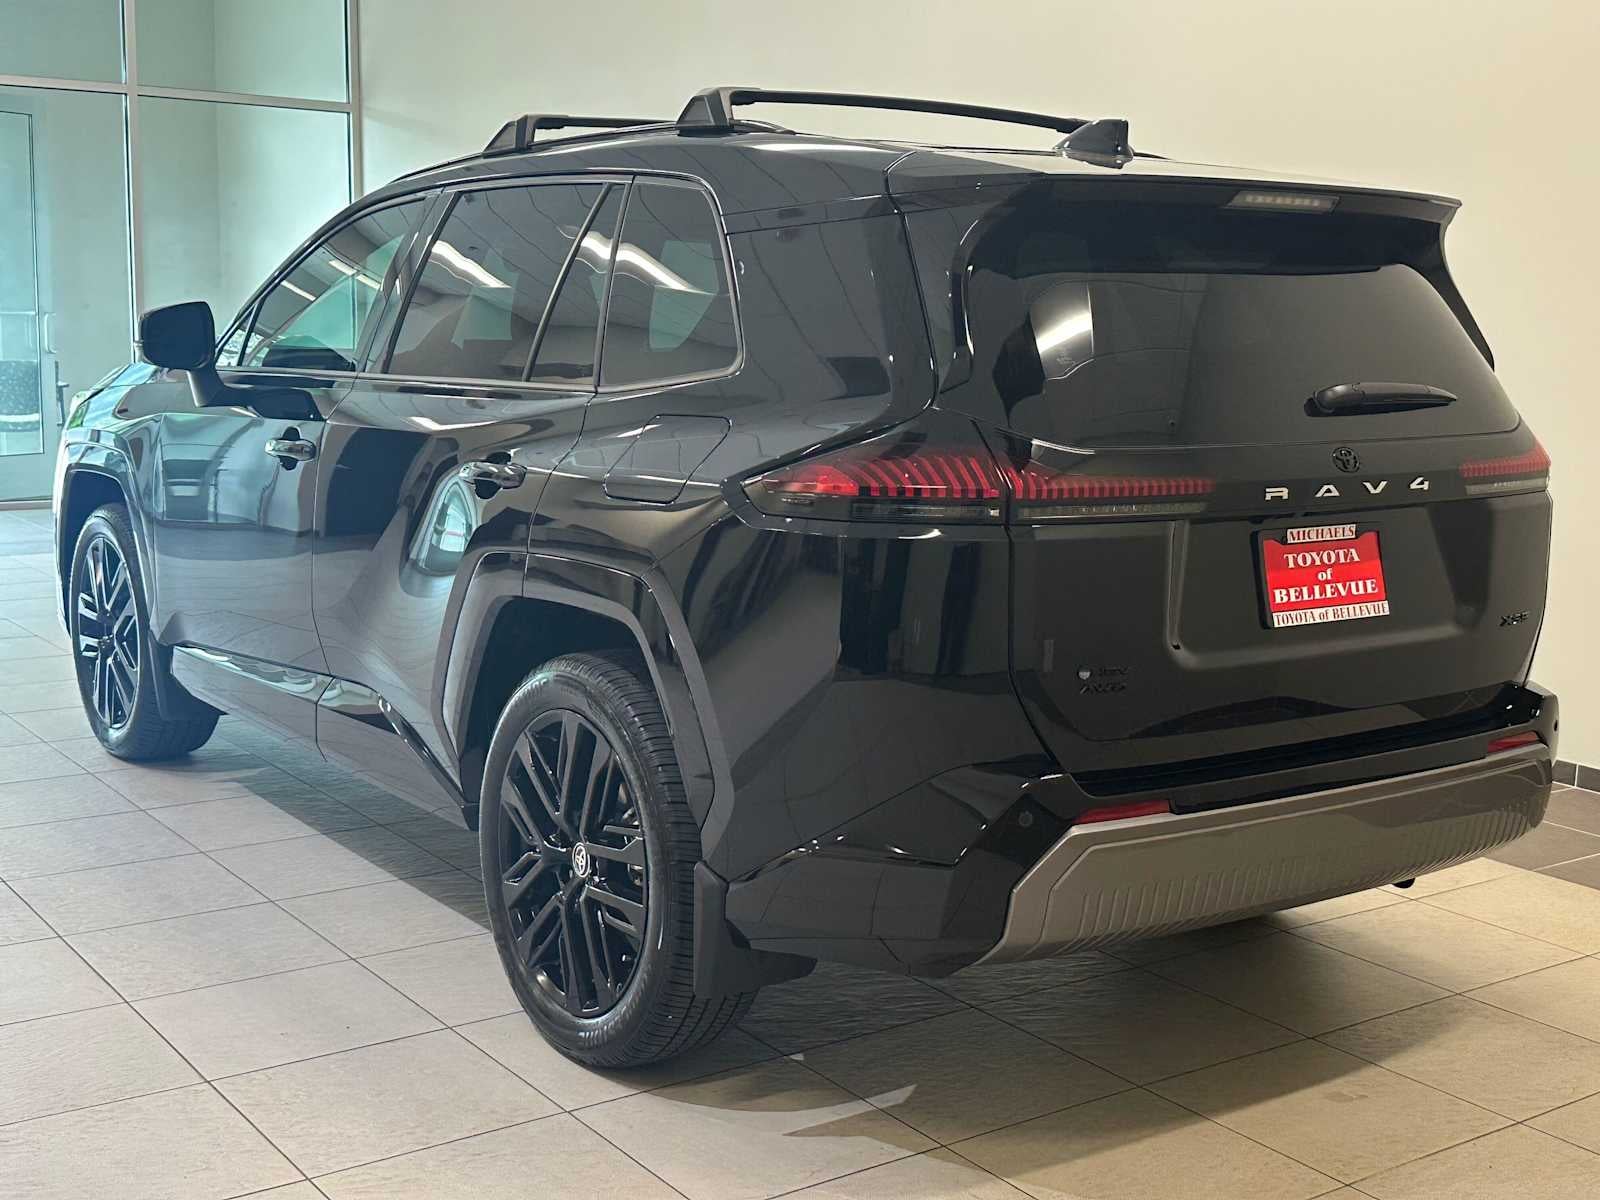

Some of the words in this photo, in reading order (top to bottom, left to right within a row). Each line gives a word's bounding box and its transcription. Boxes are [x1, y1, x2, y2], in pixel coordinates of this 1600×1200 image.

[1264, 477, 1430, 501] RAV4
[1288, 525, 1356, 542] MICHAELS
[1283, 548, 1361, 569] TOYOTA
[1317, 567, 1333, 581] of
[1273, 578, 1379, 604] BELLEVUE
[1274, 610, 1317, 626] TOYOTA
[1318, 610, 1330, 621] of
[1331, 602, 1388, 619] BELLEVUE
